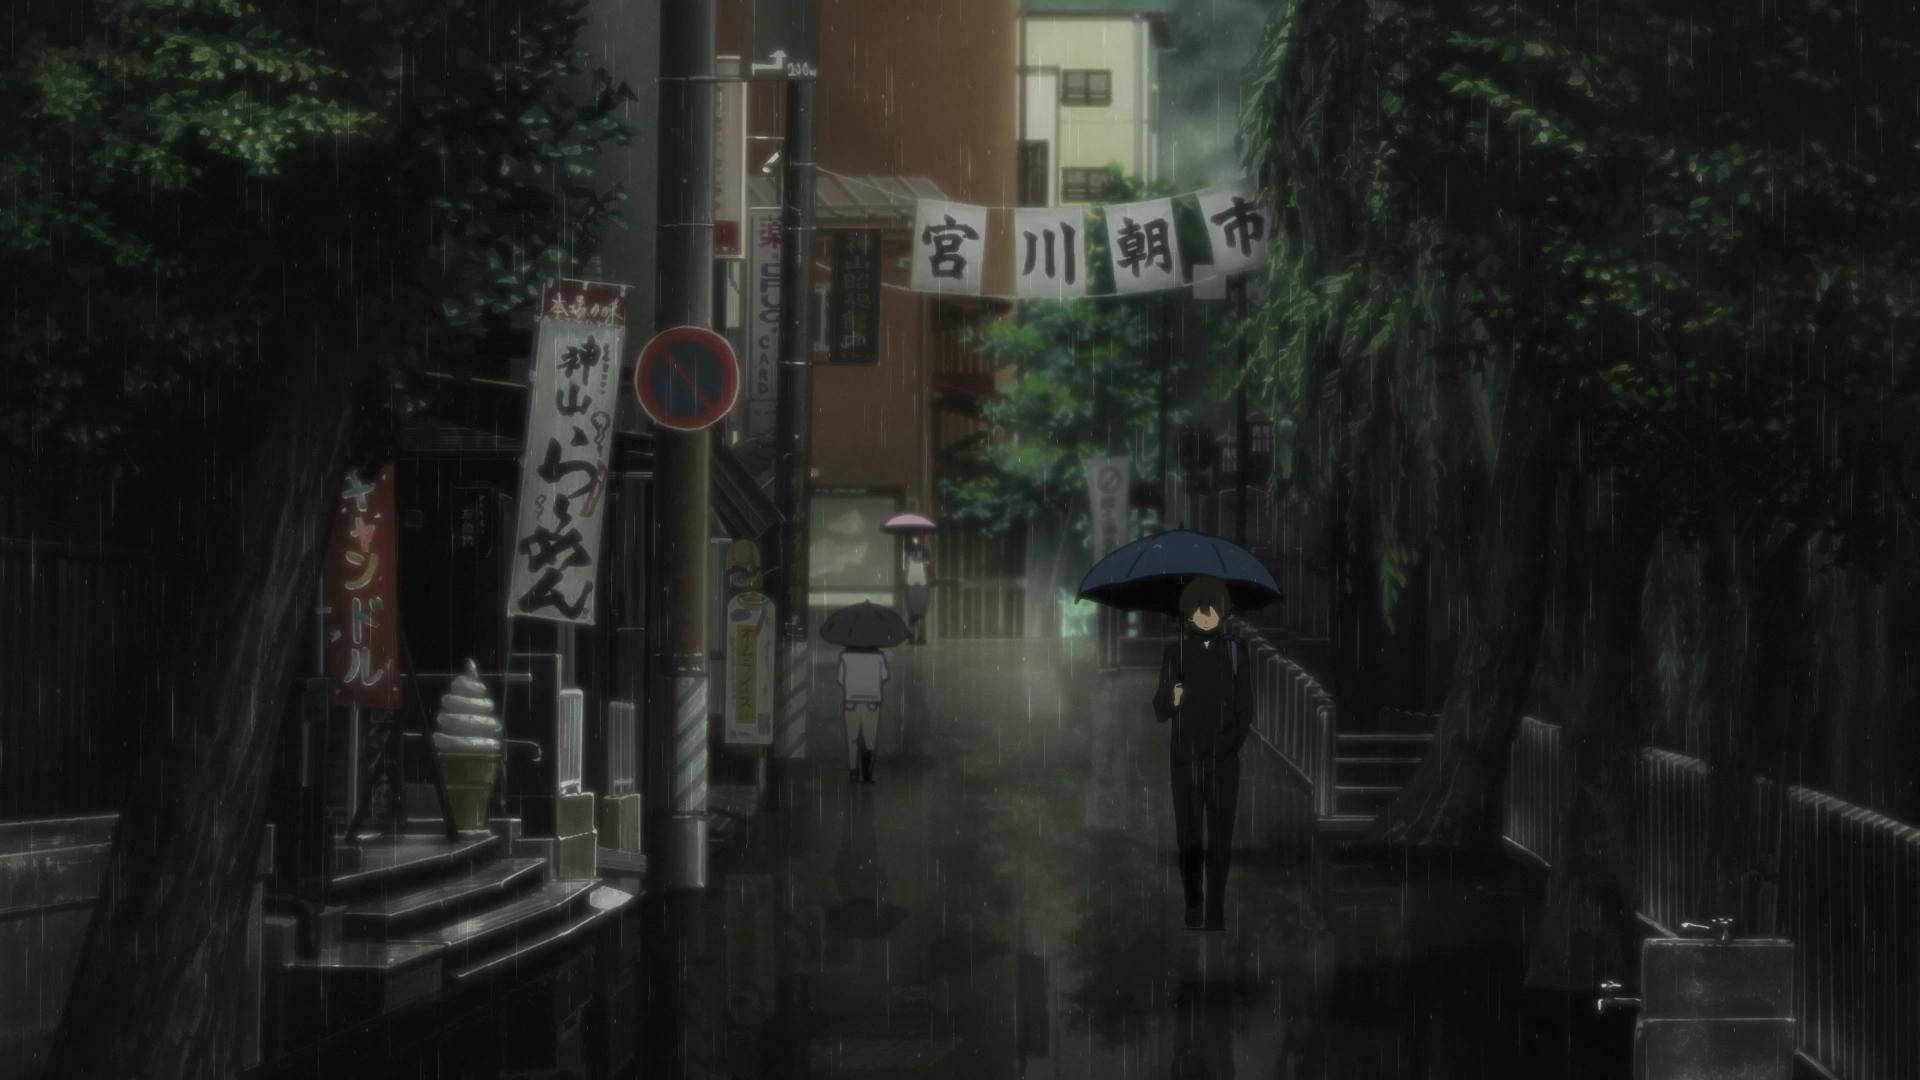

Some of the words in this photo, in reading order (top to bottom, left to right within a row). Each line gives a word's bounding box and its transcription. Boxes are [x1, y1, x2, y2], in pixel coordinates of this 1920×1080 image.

[922, 196, 1265, 285] 宮川朝市
[758, 335, 770, 395] CARD
[341, 470, 384, 687] キャンドル
